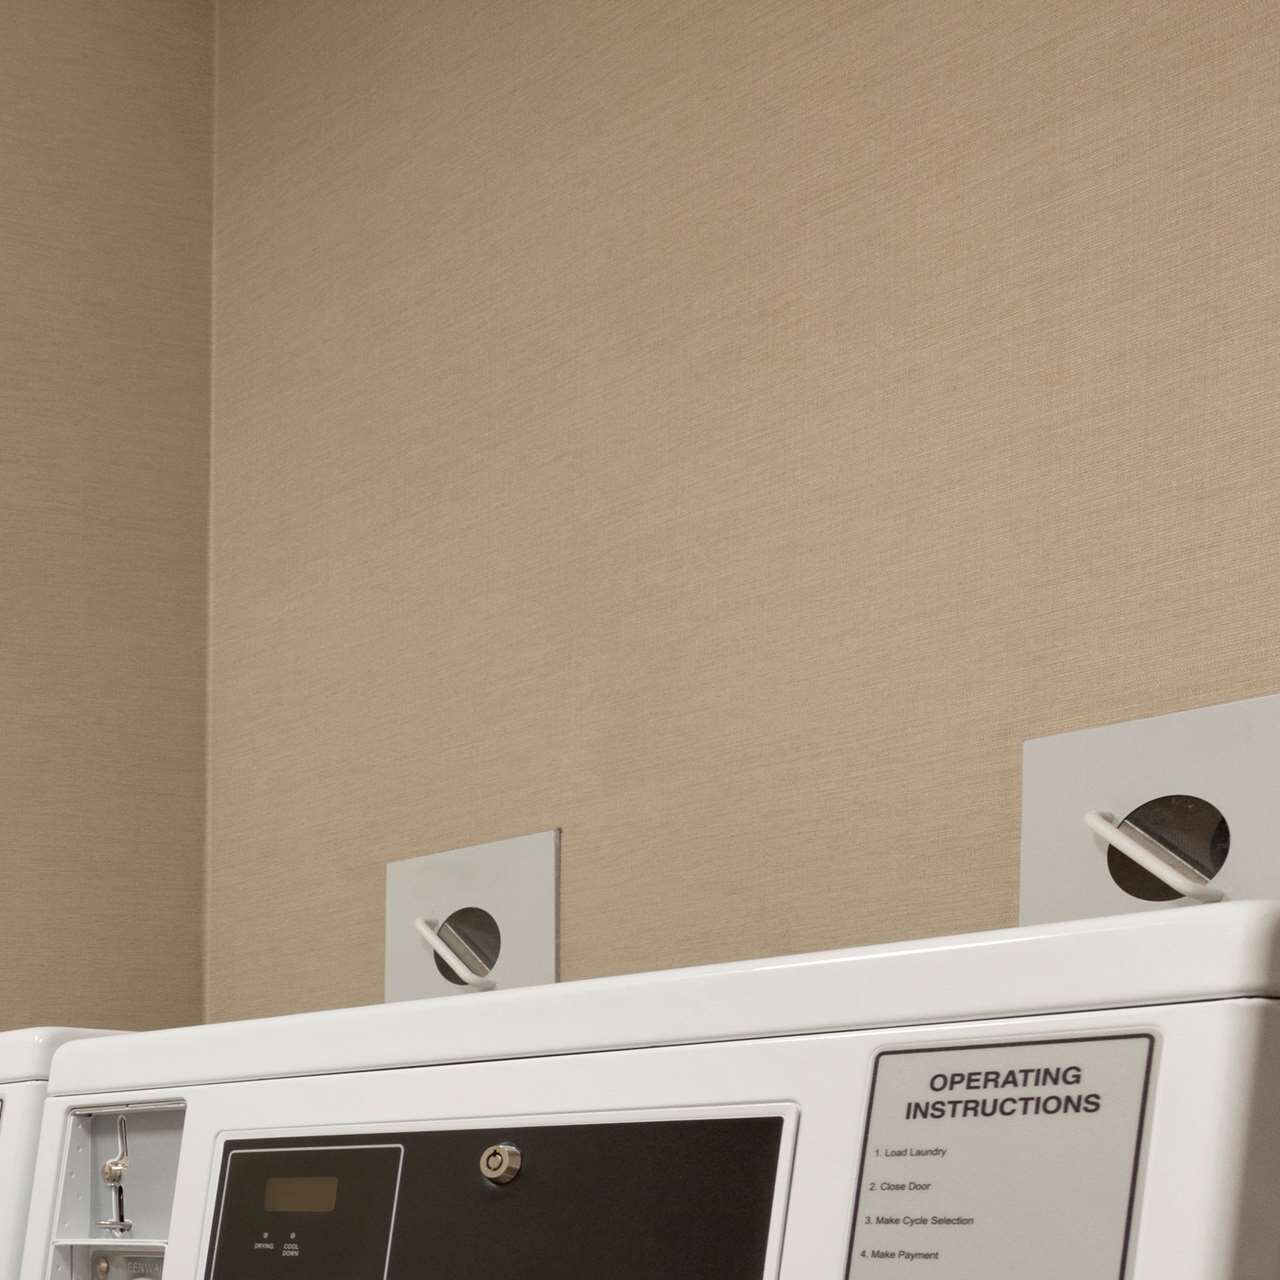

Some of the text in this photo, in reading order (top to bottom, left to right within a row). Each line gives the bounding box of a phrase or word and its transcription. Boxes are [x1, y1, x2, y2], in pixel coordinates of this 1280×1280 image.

[930, 1066, 1082, 1092] OPERATING
[905, 1094, 1101, 1120] INSTRUCTIONS
[875, 1147, 947, 1158] 1. Load Laundry
[869, 1182, 931, 1191] 2. Close Door
[865, 1216, 974, 1226] 3. Make Cycle Selection
[860, 1250, 939, 1261] 4. Make Payment
